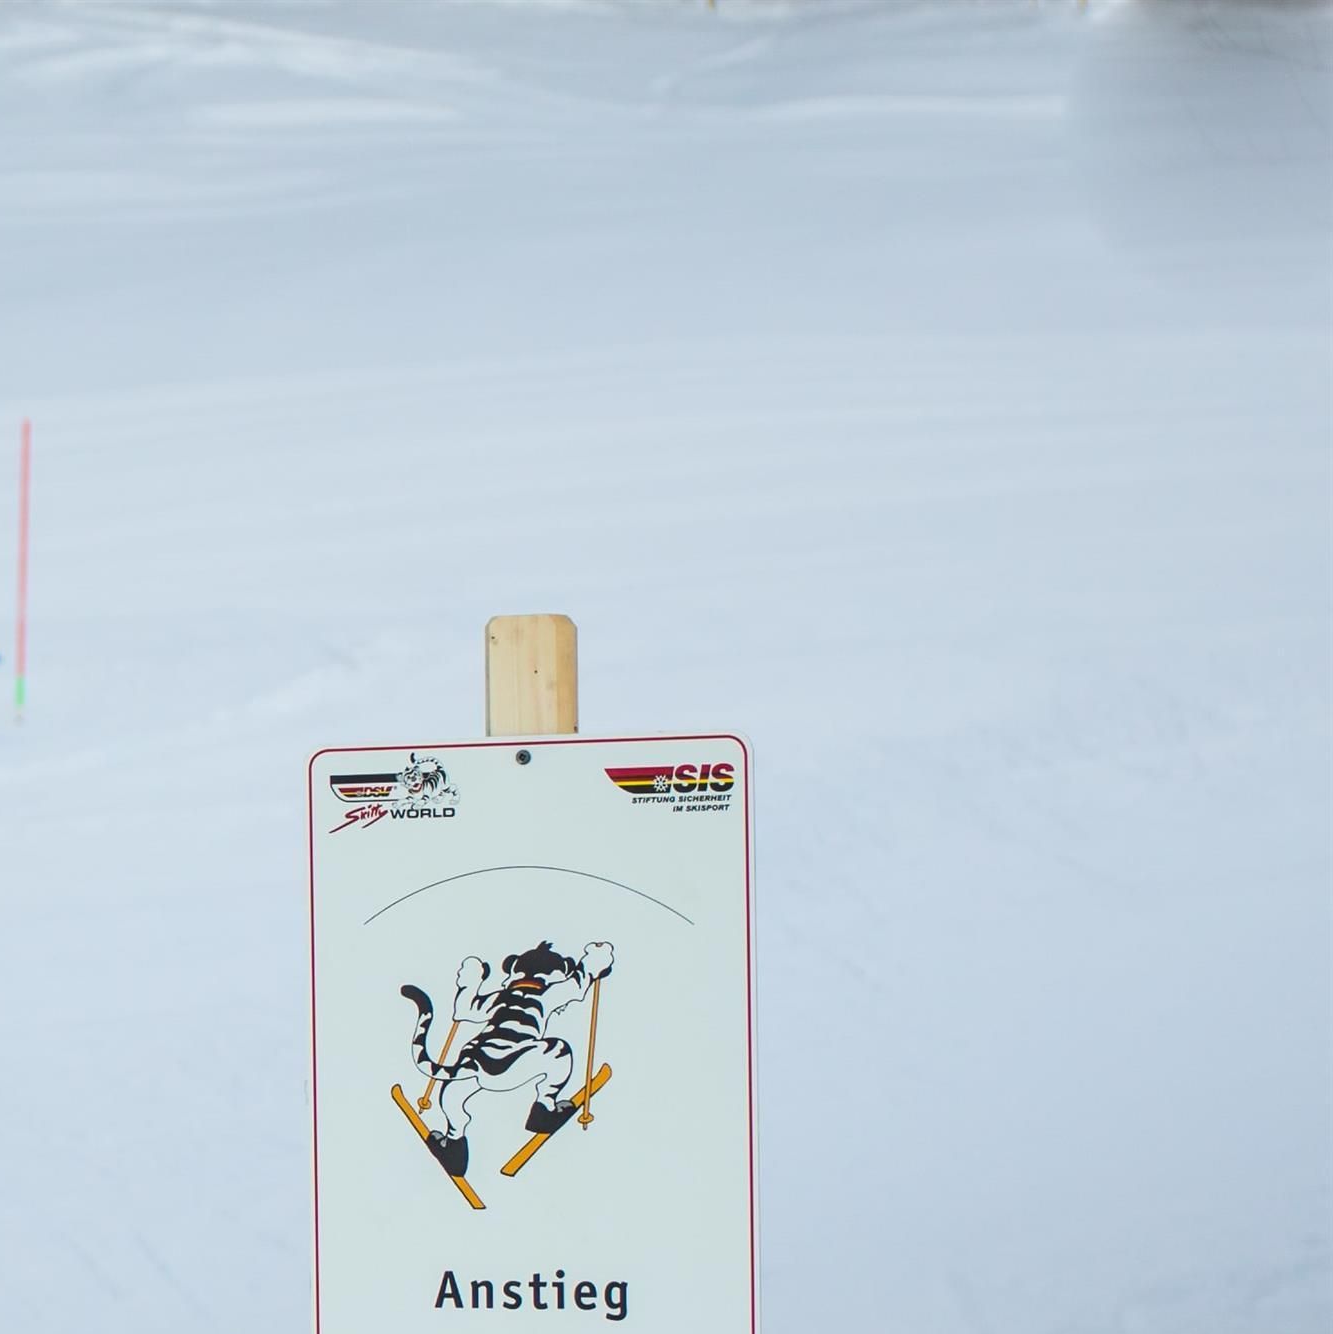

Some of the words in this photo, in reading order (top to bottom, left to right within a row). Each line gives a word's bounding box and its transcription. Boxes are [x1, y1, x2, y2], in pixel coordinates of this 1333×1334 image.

[673, 763, 735, 793] SIS
[631, 796, 676, 804] STIFTUNG
[678, 794, 732, 803] SICHERHEIT
[390, 807, 456, 819] WORLD
[685, 804, 730, 812] SKISPORT
[434, 1269, 629, 1321] Anstieg
